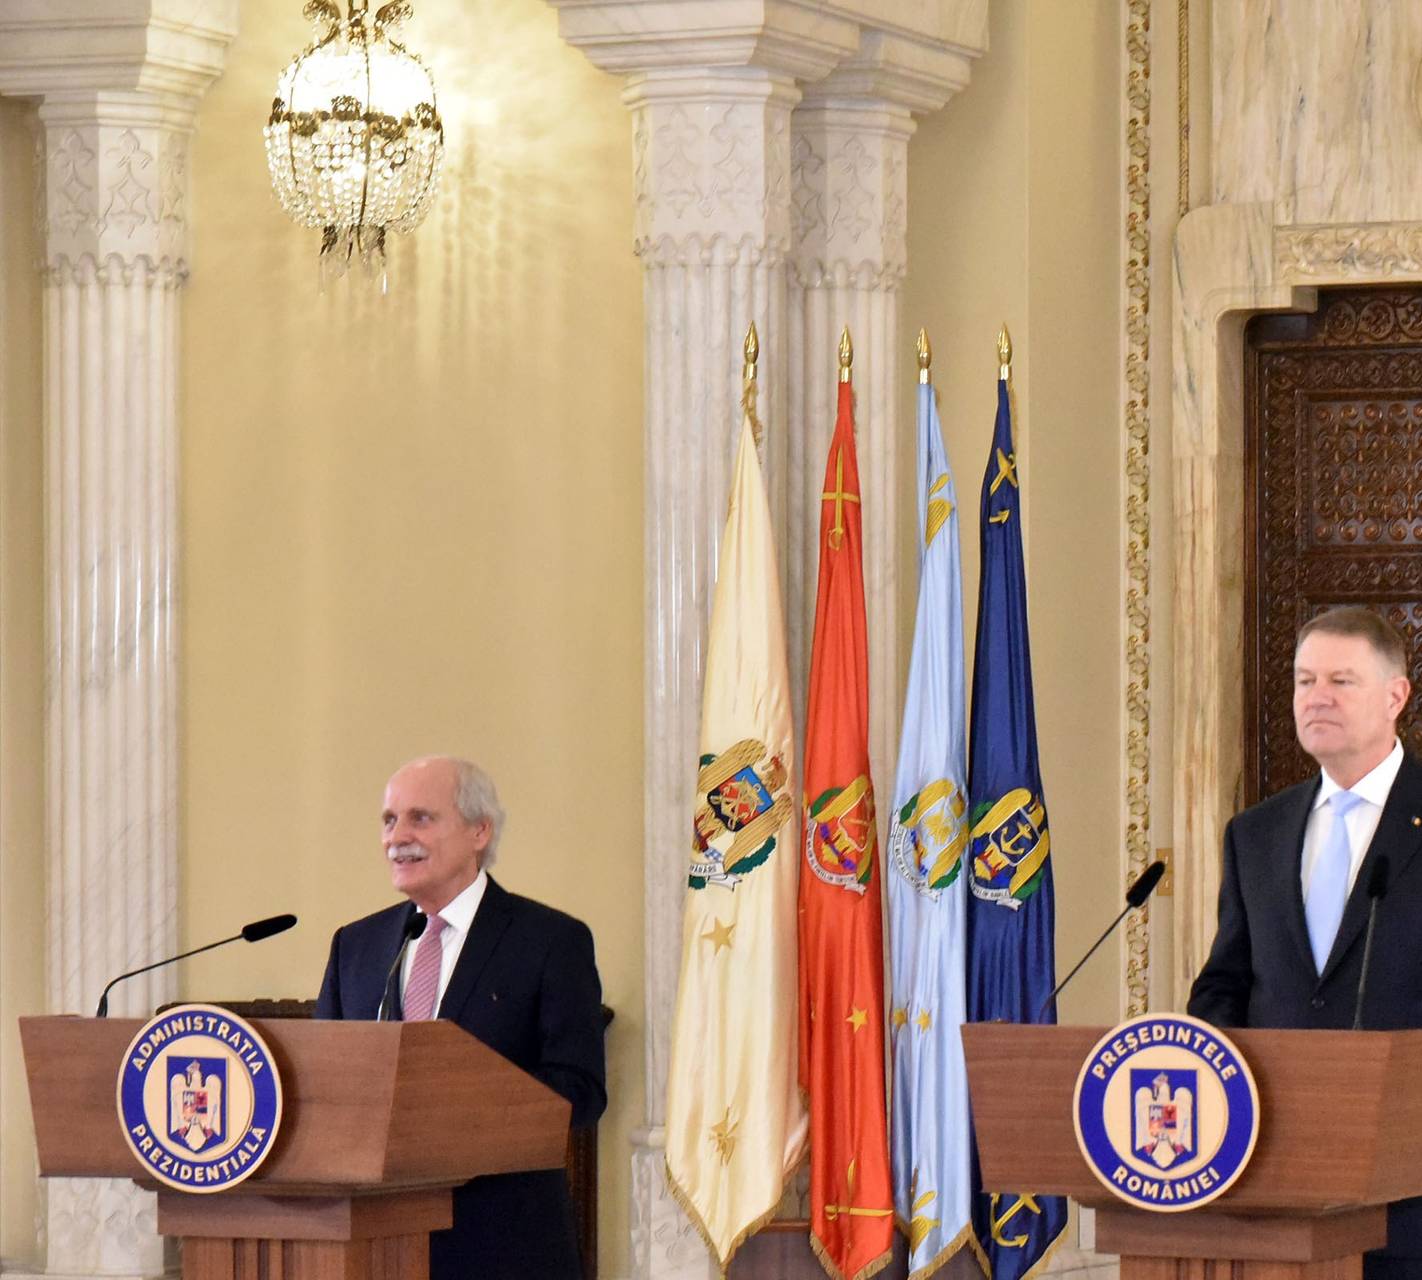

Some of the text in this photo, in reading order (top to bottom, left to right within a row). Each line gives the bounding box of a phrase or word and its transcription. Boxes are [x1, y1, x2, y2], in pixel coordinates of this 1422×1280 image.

[1092, 1024, 1238, 1081] PREȘEDINTELE
[131, 1123, 267, 1183] PREZIDENȚIALĂ
[1112, 1165, 1221, 1201] ROMÂNIEI
